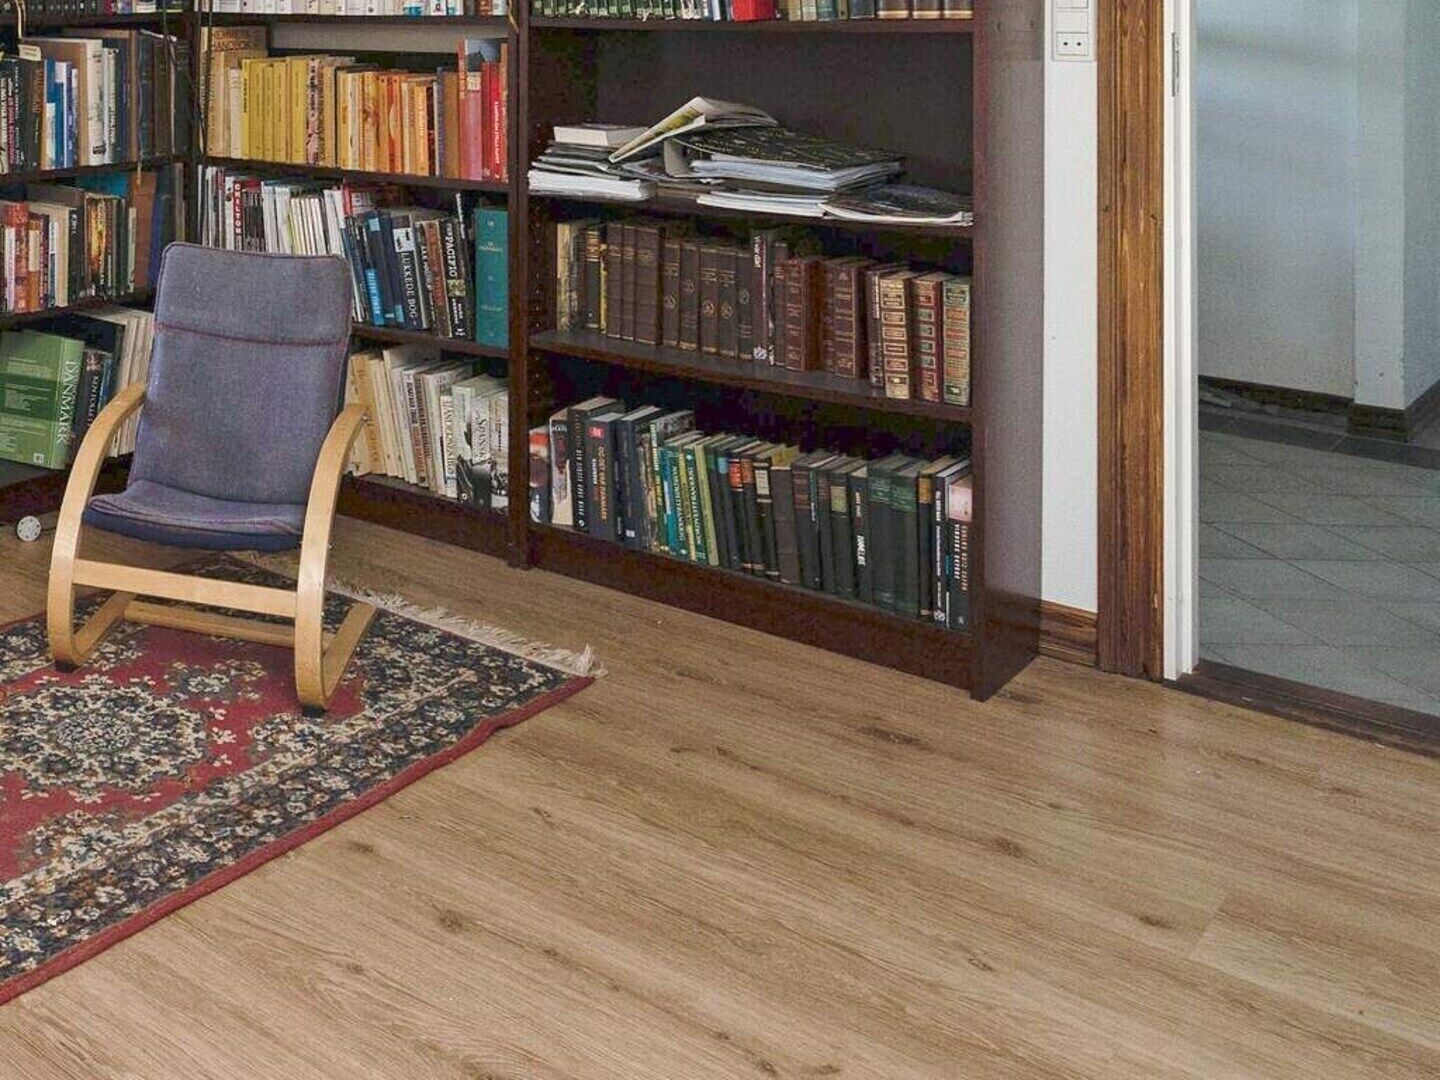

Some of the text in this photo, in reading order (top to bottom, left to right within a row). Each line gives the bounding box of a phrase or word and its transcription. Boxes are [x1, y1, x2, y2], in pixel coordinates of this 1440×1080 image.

[234, 182, 242, 235] CHILTON
[401, 252, 417, 318] LUKKEDE BOG
[446, 236, 458, 278] PACIFIC
[56, 360, 76, 445] DANMARK
